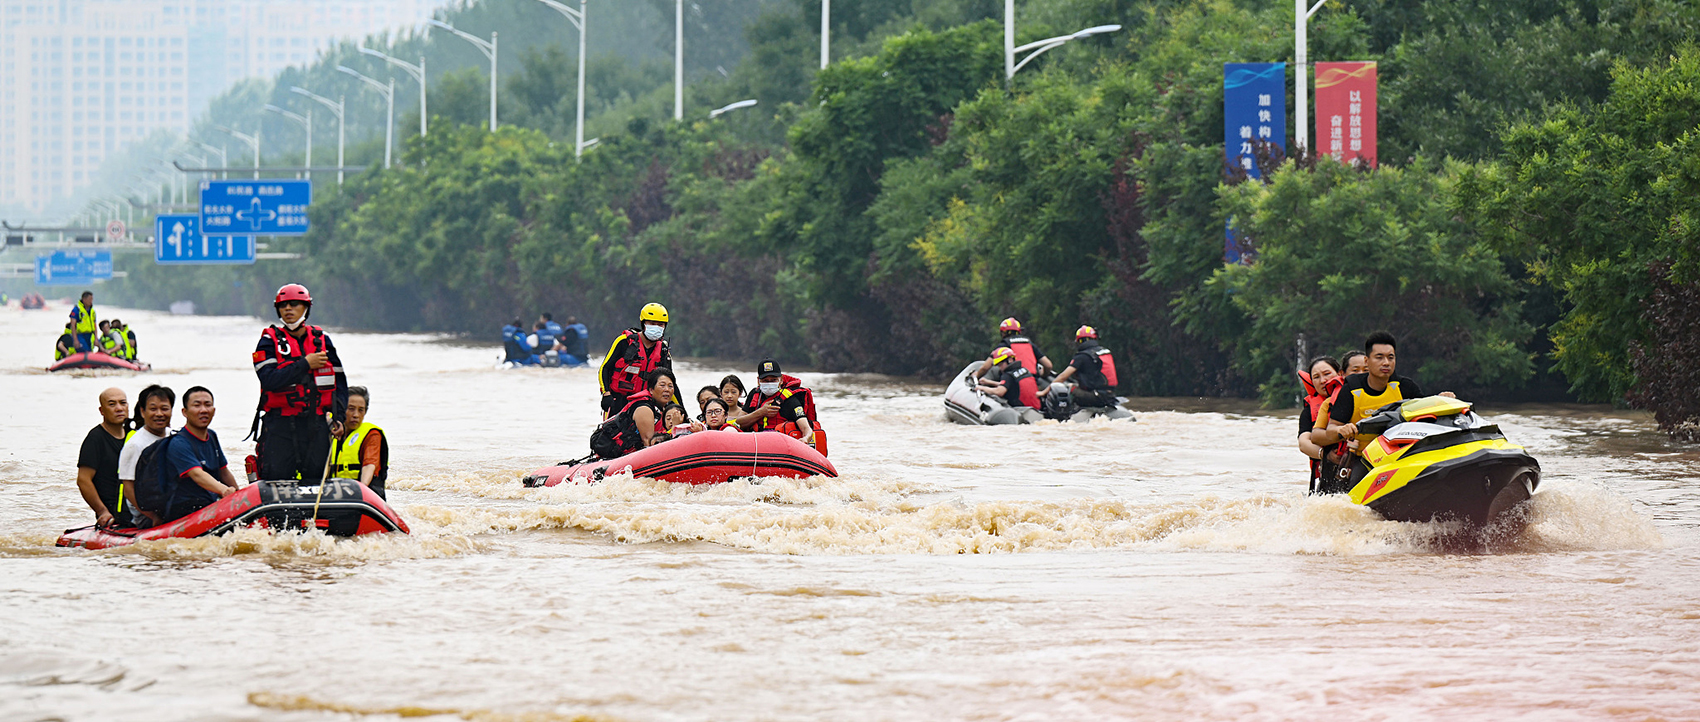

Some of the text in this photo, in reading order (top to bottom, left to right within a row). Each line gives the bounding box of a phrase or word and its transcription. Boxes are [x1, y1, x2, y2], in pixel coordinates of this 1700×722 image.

[1349, 90, 1362, 151] 以解放思想
